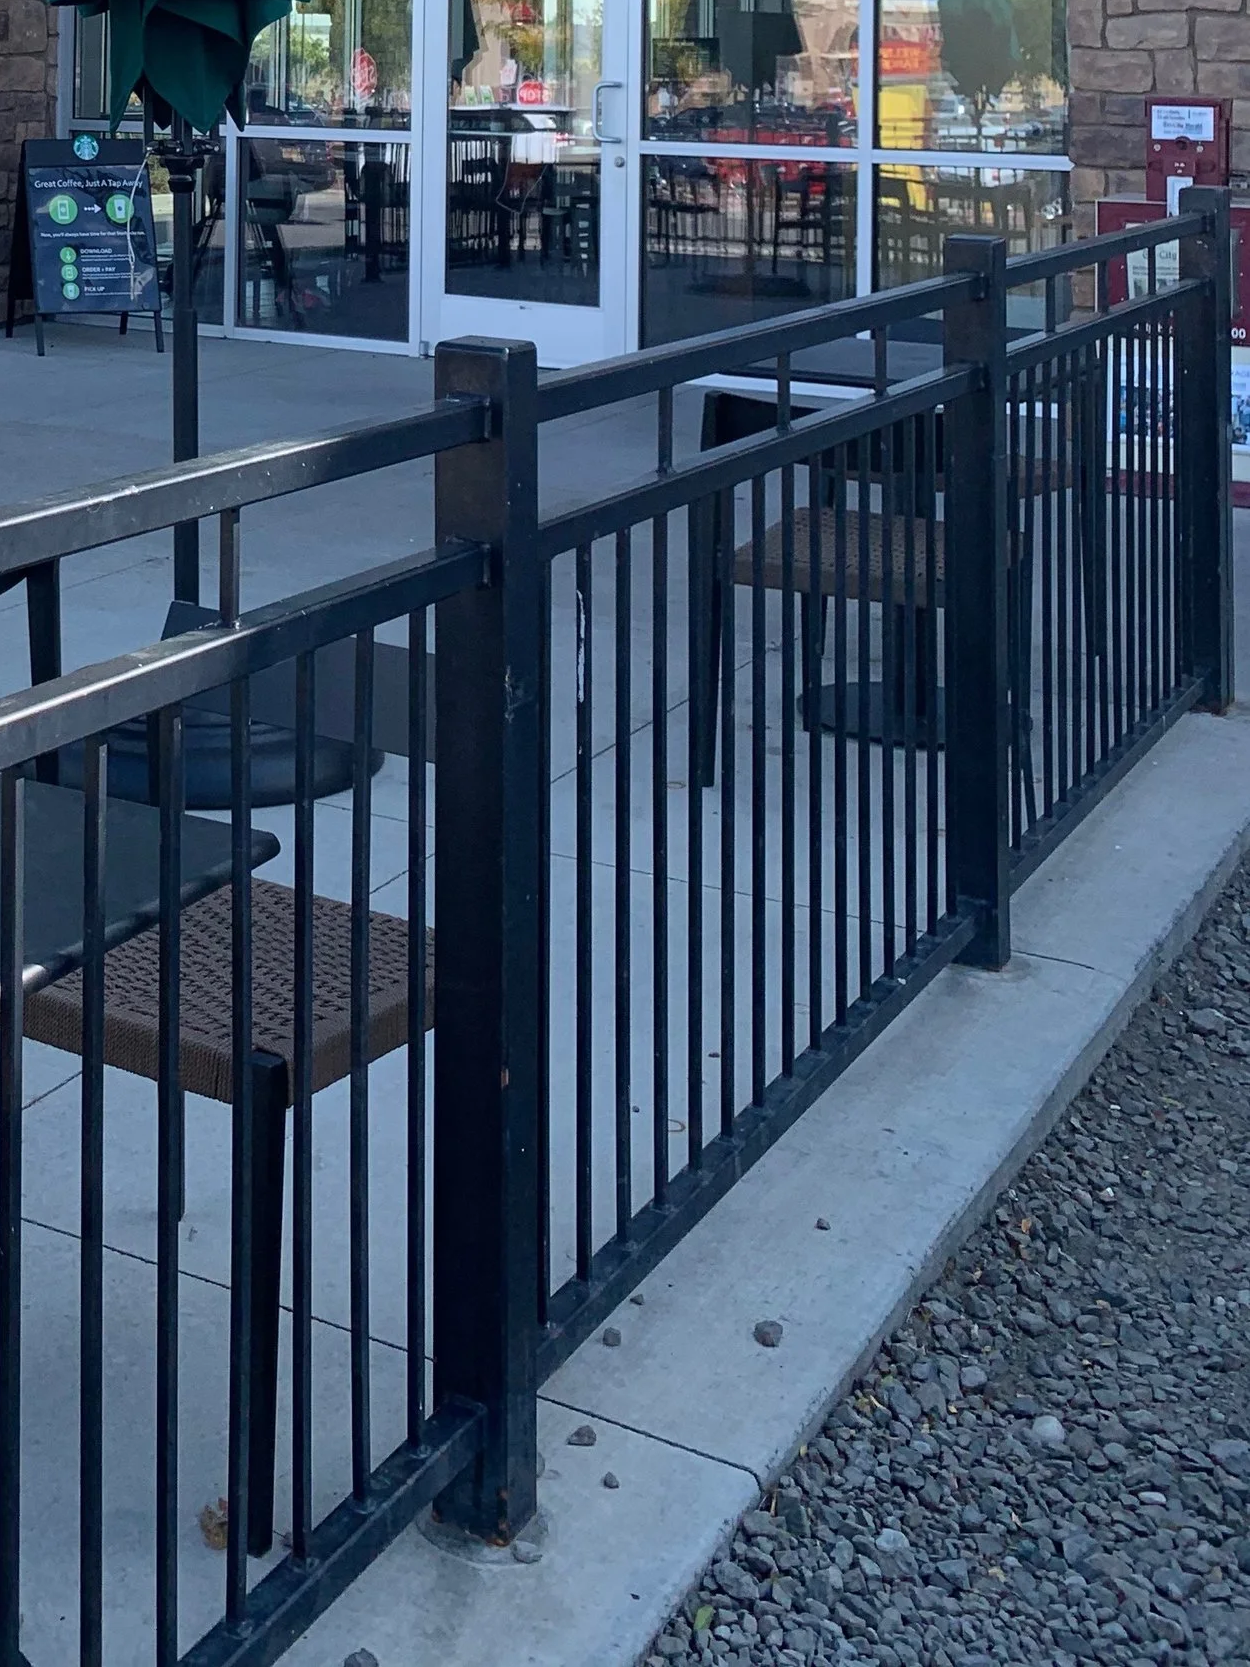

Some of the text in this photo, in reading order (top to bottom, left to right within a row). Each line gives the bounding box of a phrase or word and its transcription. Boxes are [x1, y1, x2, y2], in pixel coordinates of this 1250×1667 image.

[34, 180, 56, 188] Great
[57, 179, 84, 188] Coffee,
[85, 179, 101, 188] Just
[101, 179, 108, 187] A
[108, 179, 121, 189] Tap
